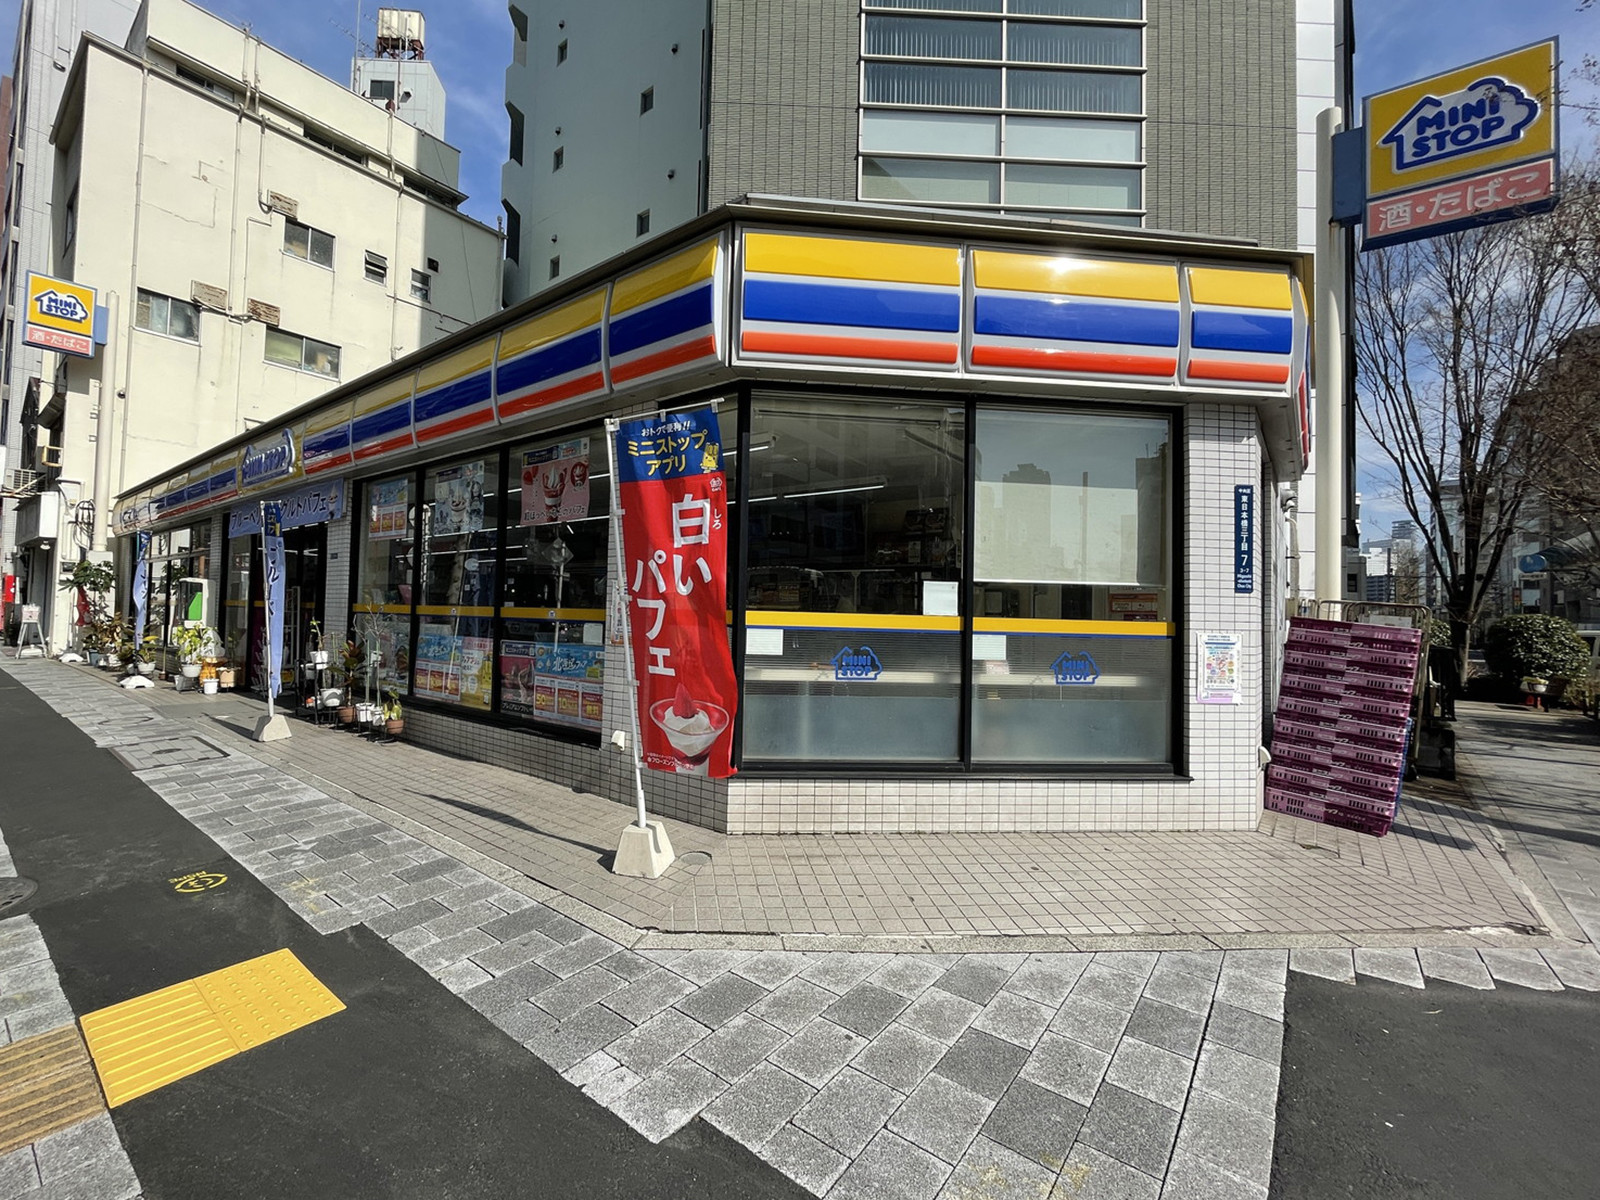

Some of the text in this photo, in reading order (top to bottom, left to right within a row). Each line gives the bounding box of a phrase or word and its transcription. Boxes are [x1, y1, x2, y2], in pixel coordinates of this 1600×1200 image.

[1416, 94, 1500, 136] MINI
[1411, 114, 1505, 158] STOP
[1379, 171, 1541, 231] 酒・たばこ
[46, 304, 78, 317] STOP
[48, 296, 77, 310] MINI
[32, 330, 87, 351] 酒・たばこ
[627, 430, 709, 457] ミニストップ
[646, 453, 687, 477] アプリ
[712, 508, 723, 530] しろ
[1240, 495, 1249, 566] 東日本橋三丁目 7
[672, 493, 713, 597] 白い
[632, 549, 676, 678] パフェ
[840, 665, 873, 677] STOP
[842, 655, 871, 666] MINI
[1062, 660, 1090, 671] MINI
[1060, 670, 1091, 681] STOP
